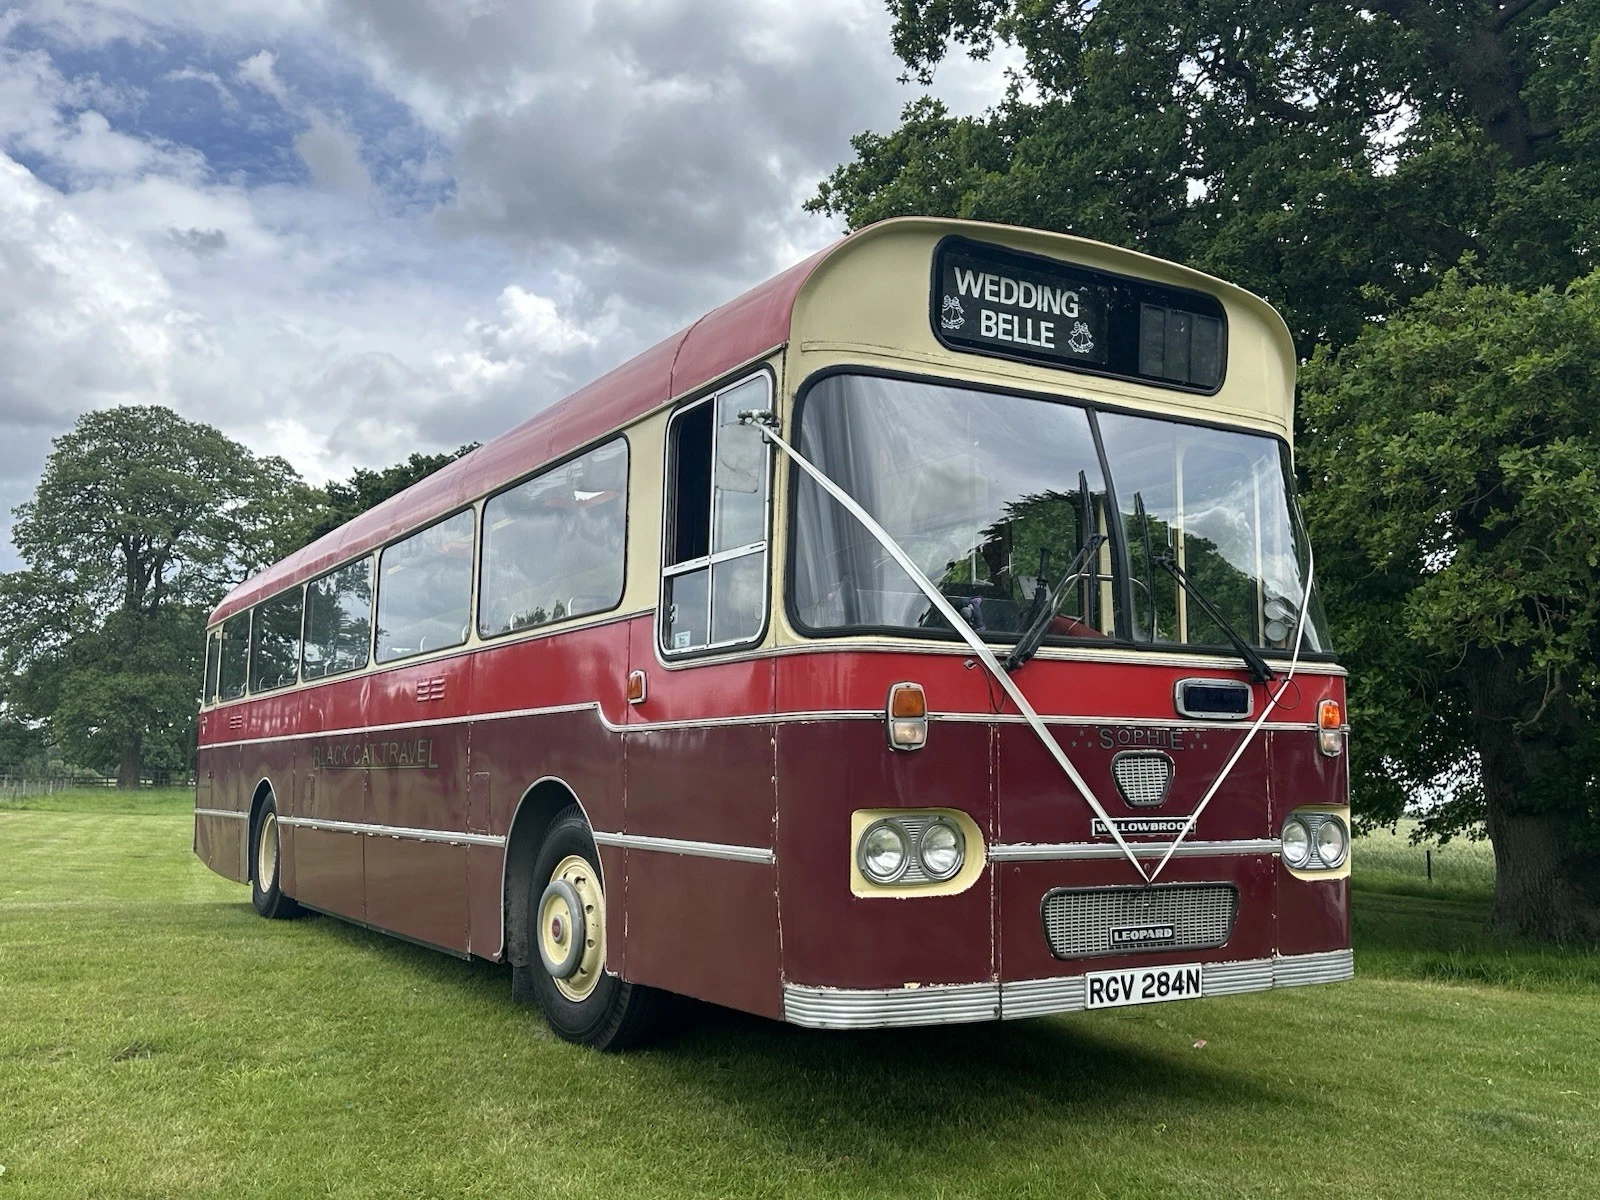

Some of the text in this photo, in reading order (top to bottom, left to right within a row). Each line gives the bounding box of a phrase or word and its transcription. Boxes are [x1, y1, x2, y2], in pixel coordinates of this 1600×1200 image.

[954, 266, 1079, 318] WEDDING
[980, 309, 1055, 349] BELLE
[312, 738, 439, 770] BLACK CAT TRAVEL
[1099, 728, 1185, 750] SOPHIE
[1114, 929, 1173, 942] LEOPARD
[1089, 968, 1200, 1005] RGV 284N
